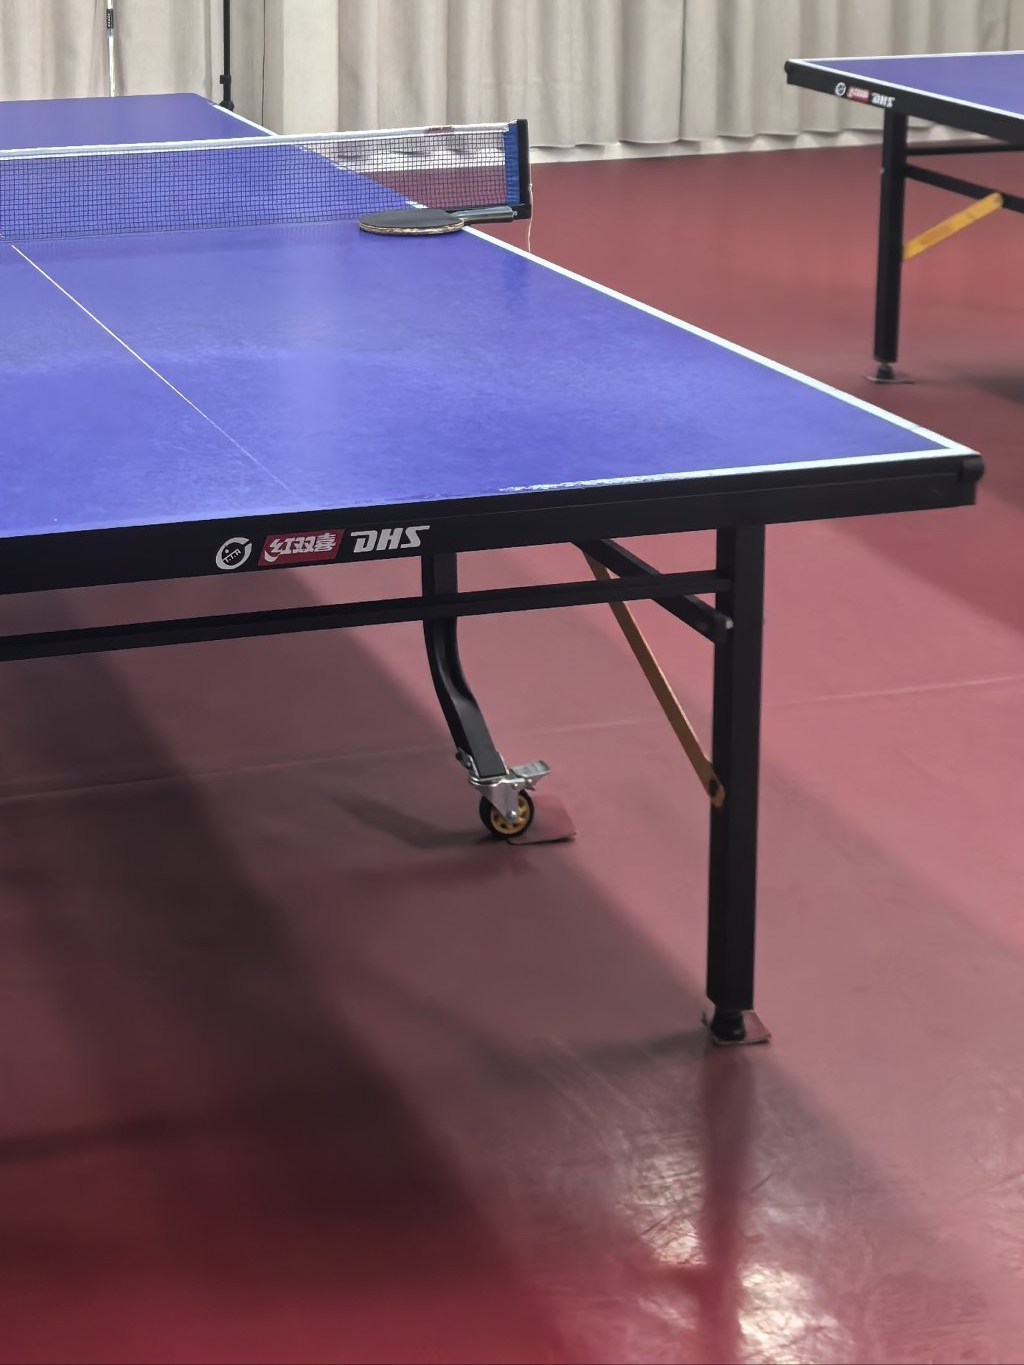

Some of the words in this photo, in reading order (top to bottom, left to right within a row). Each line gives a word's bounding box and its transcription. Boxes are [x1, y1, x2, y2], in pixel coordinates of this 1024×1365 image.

[268, 532, 337, 556] 红双喜
[350, 525, 430, 553] DHS
